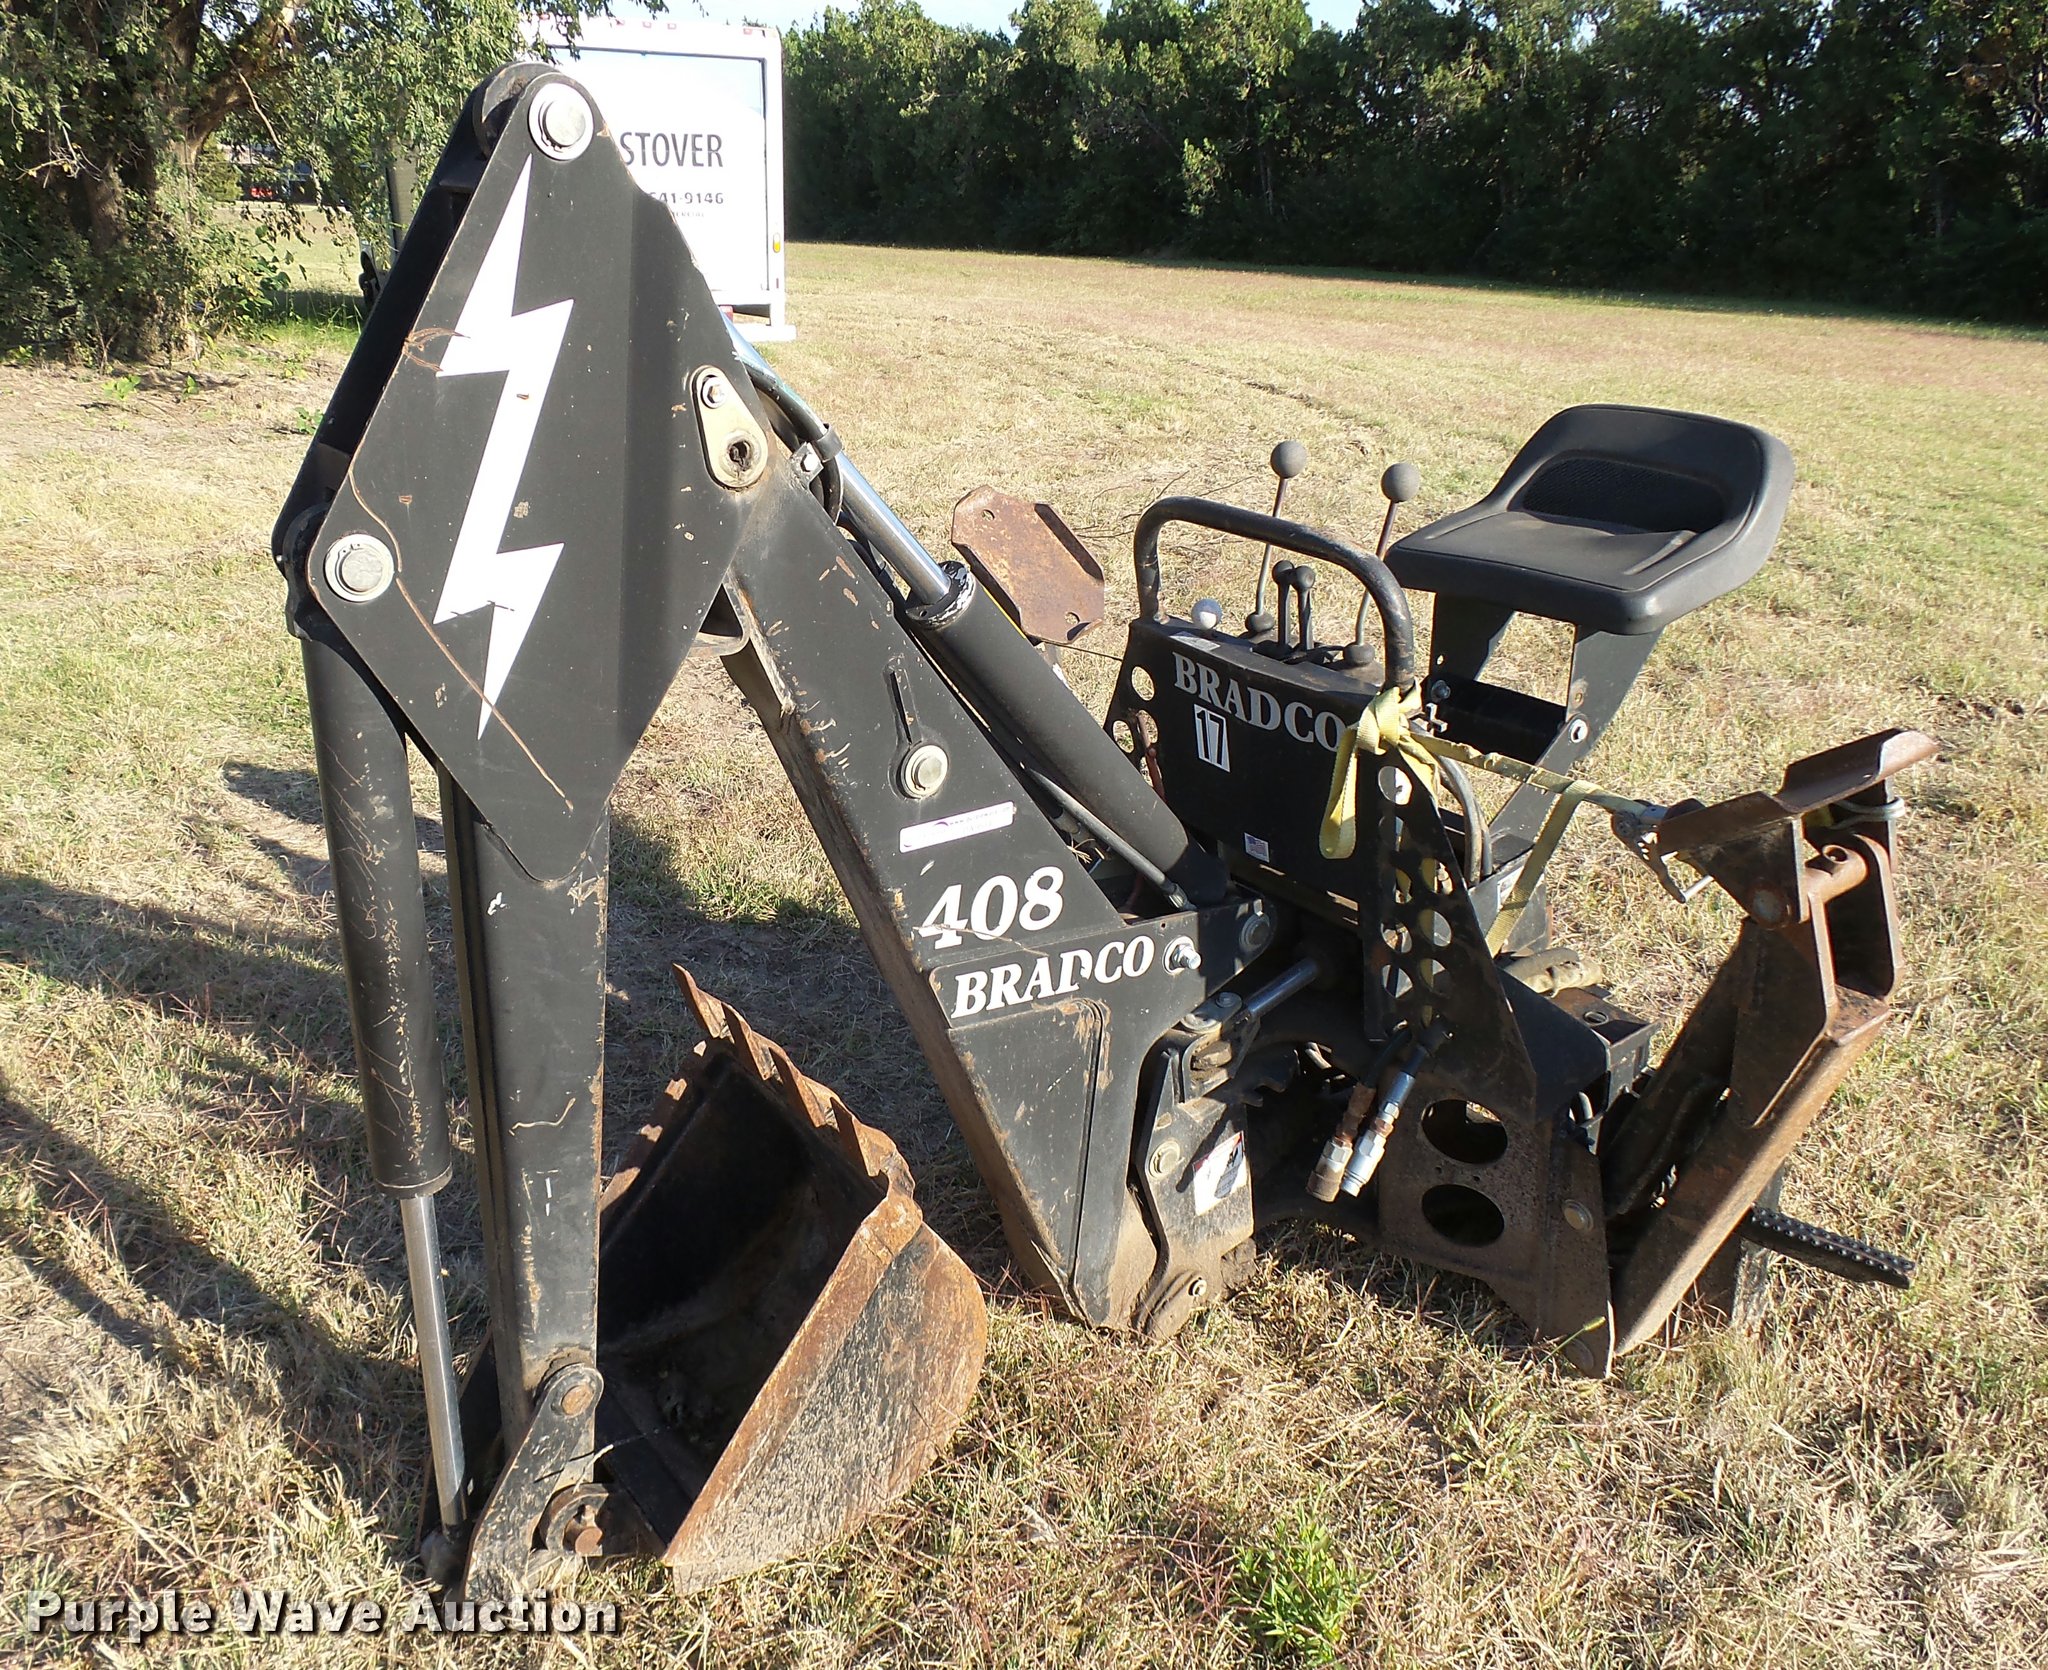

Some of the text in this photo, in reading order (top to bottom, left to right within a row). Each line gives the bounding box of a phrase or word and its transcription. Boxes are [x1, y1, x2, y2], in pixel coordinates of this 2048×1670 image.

[620, 131, 723, 167] STOVER
[1173, 652, 1349, 752] BRADCO
[1196, 706, 1226, 767] 17
[918, 865, 1065, 949] 408
[950, 935, 1155, 1018] BRADCO
